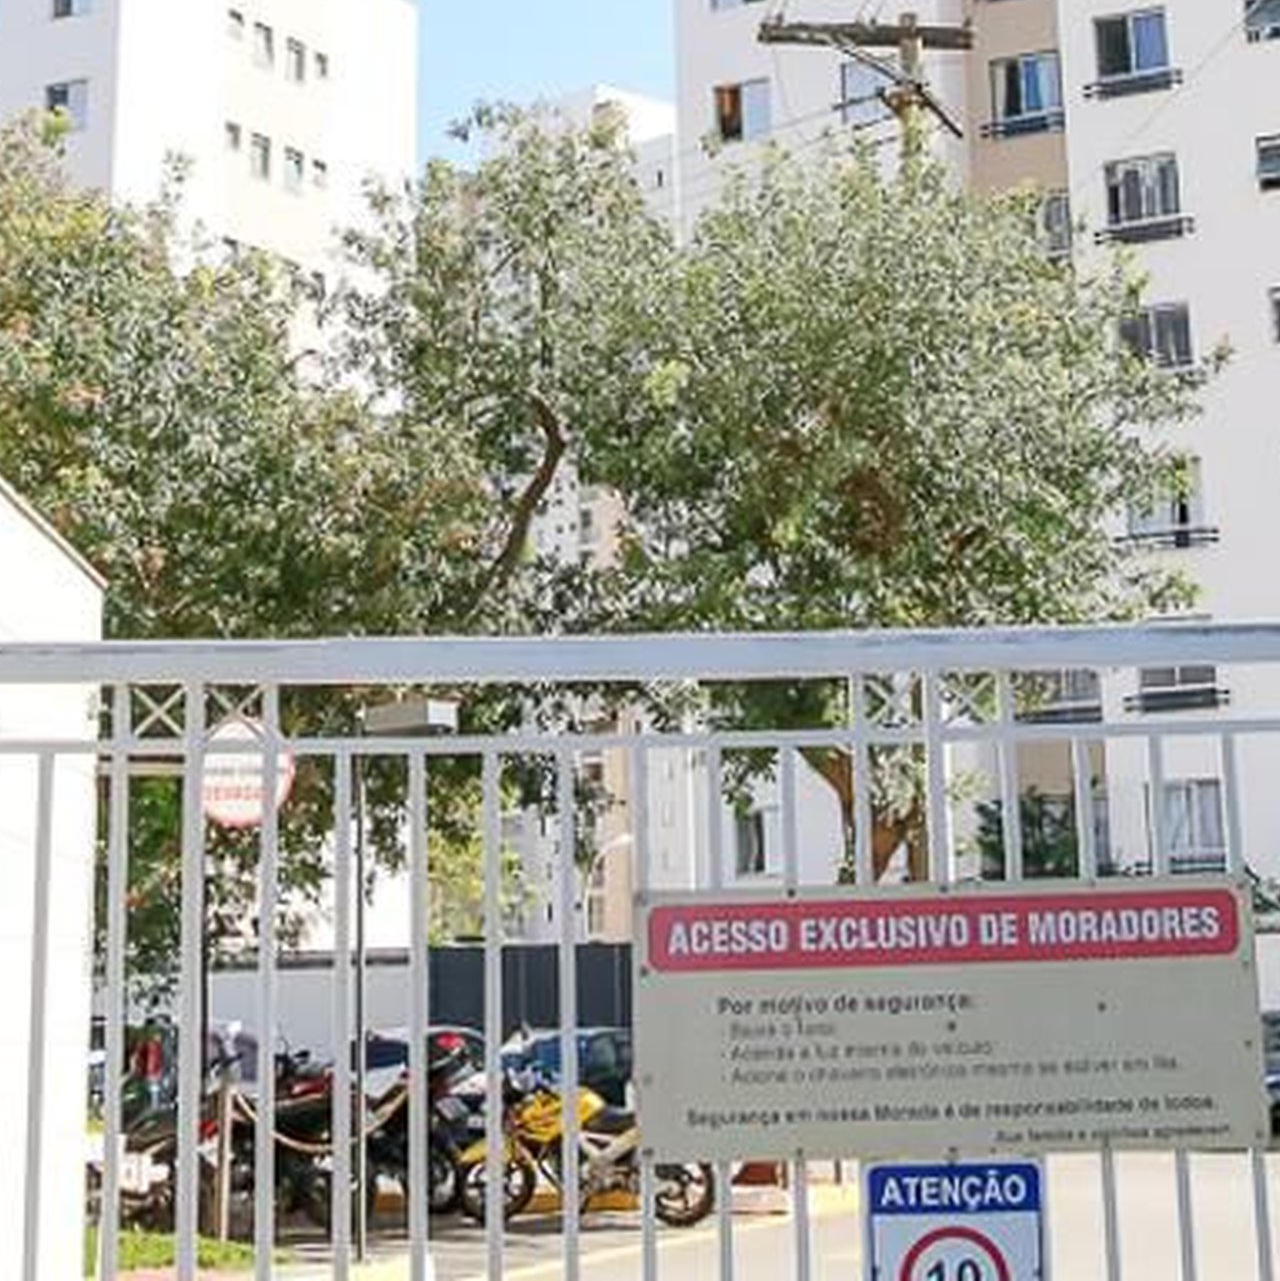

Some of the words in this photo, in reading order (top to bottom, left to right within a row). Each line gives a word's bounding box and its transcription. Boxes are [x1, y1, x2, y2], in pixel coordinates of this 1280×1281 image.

[668, 920, 789, 955] ACESSO
[800, 913, 969, 951] EXCLUSIVO
[979, 914, 1018, 946] DE
[1028, 906, 1220, 944] MORADORES
[718, 997, 752, 1016] Por
[760, 994, 829, 1016] motivo
[833, 994, 858, 1013] de
[880, 1168, 1027, 1210] ATENÇÃO
